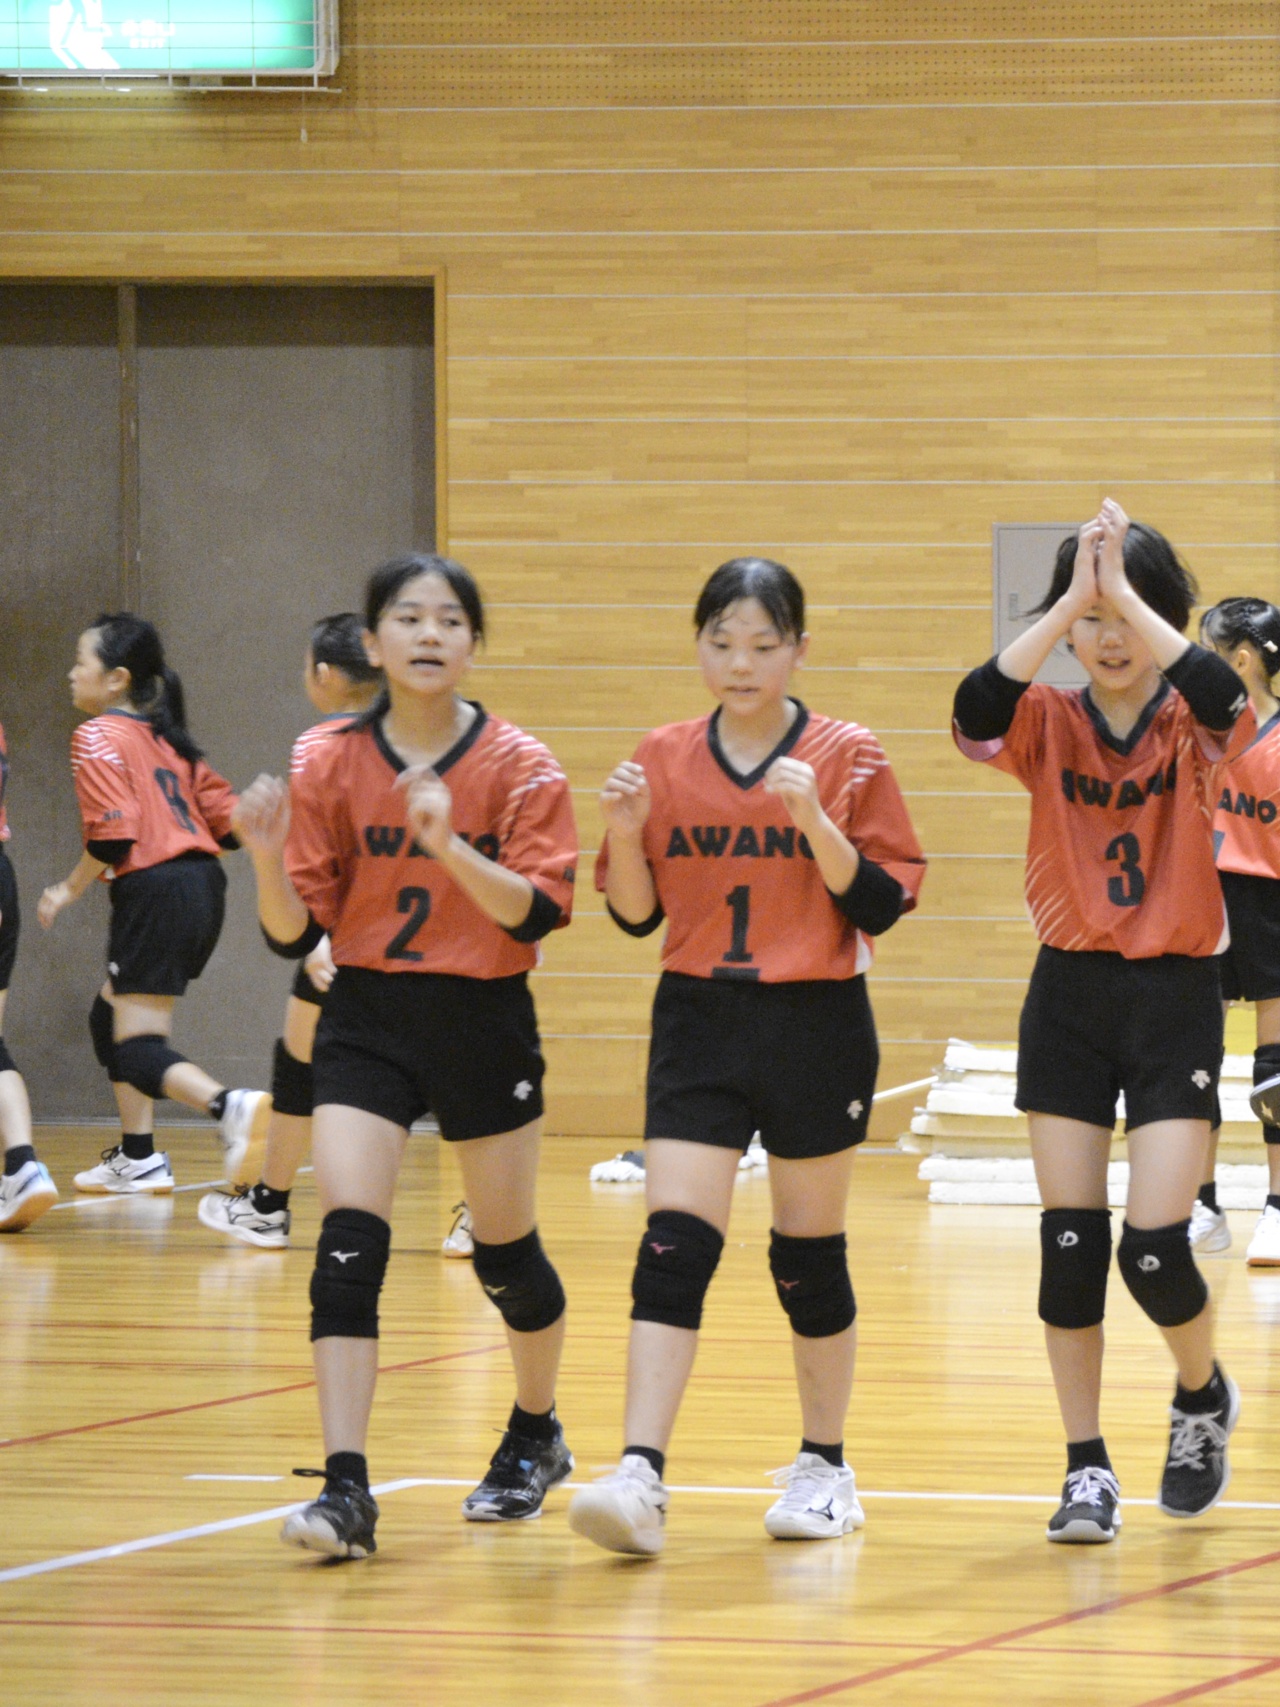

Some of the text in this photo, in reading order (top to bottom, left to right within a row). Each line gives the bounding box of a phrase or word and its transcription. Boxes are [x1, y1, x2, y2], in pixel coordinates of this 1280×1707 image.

[1104, 832, 1145, 906] 3
[384, 885, 431, 961] 2
[726, 885, 754, 963] 1
